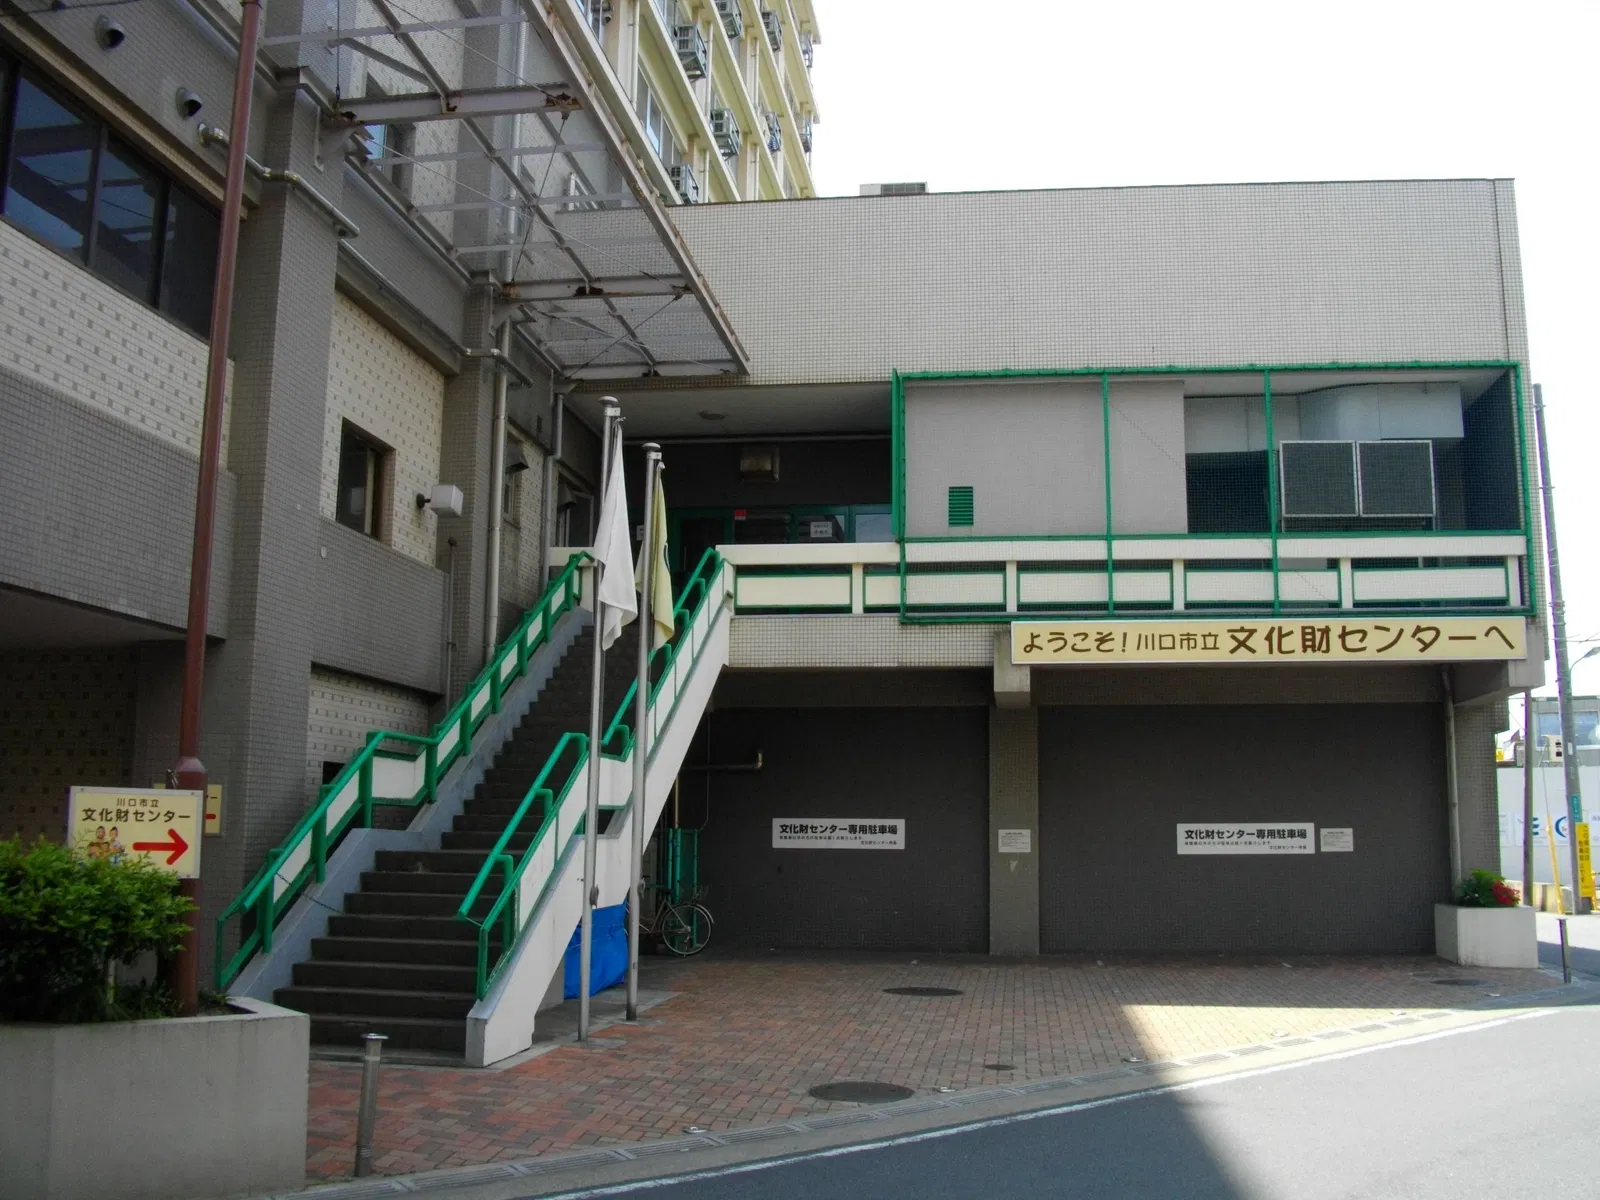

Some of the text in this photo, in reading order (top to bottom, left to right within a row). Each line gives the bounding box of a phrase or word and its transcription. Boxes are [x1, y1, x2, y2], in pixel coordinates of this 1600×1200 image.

[116, 798, 159, 808] 川口市立
[82, 808, 191, 823] 文化財センター
[779, 824, 898, 835] 文化財センター専用駐車場
[1184, 829, 1307, 840] 文化財センター専用駐車場
